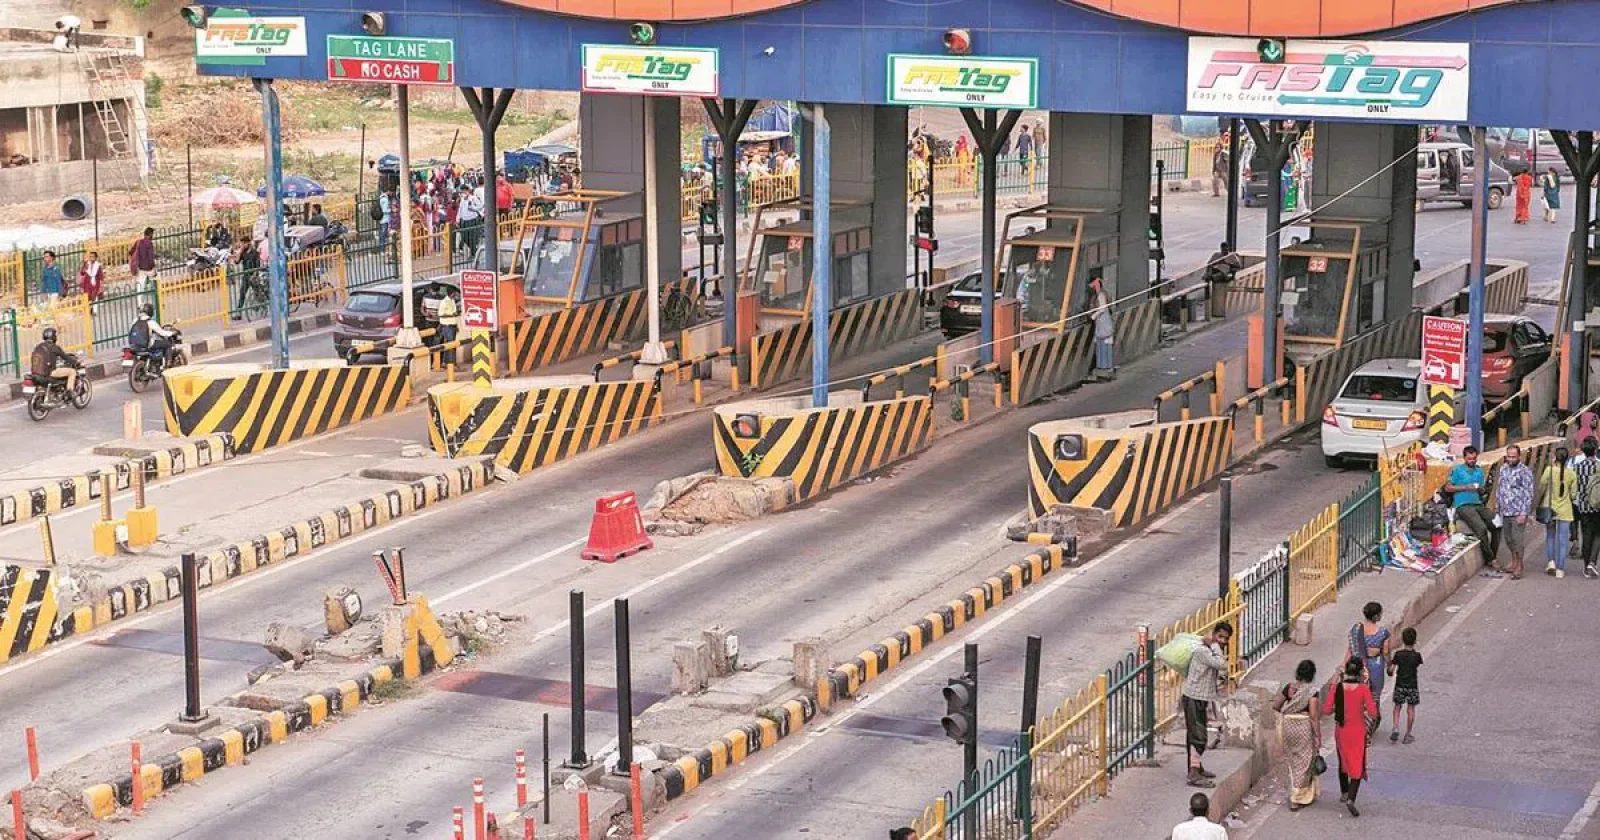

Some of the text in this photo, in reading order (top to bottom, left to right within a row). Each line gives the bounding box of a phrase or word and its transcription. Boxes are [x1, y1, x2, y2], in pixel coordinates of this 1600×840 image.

[255, 47, 272, 55] ONLY
[353, 41, 427, 58] TAG LANE
[361, 63, 420, 79] NO CASH
[966, 93, 985, 102] ONLY
[1192, 91, 1274, 102] Easy to Cruise
[1366, 104, 1390, 113] ONLY
[1310, 260, 1325, 270] 32
[1427, 320, 1462, 332] CAUTION
